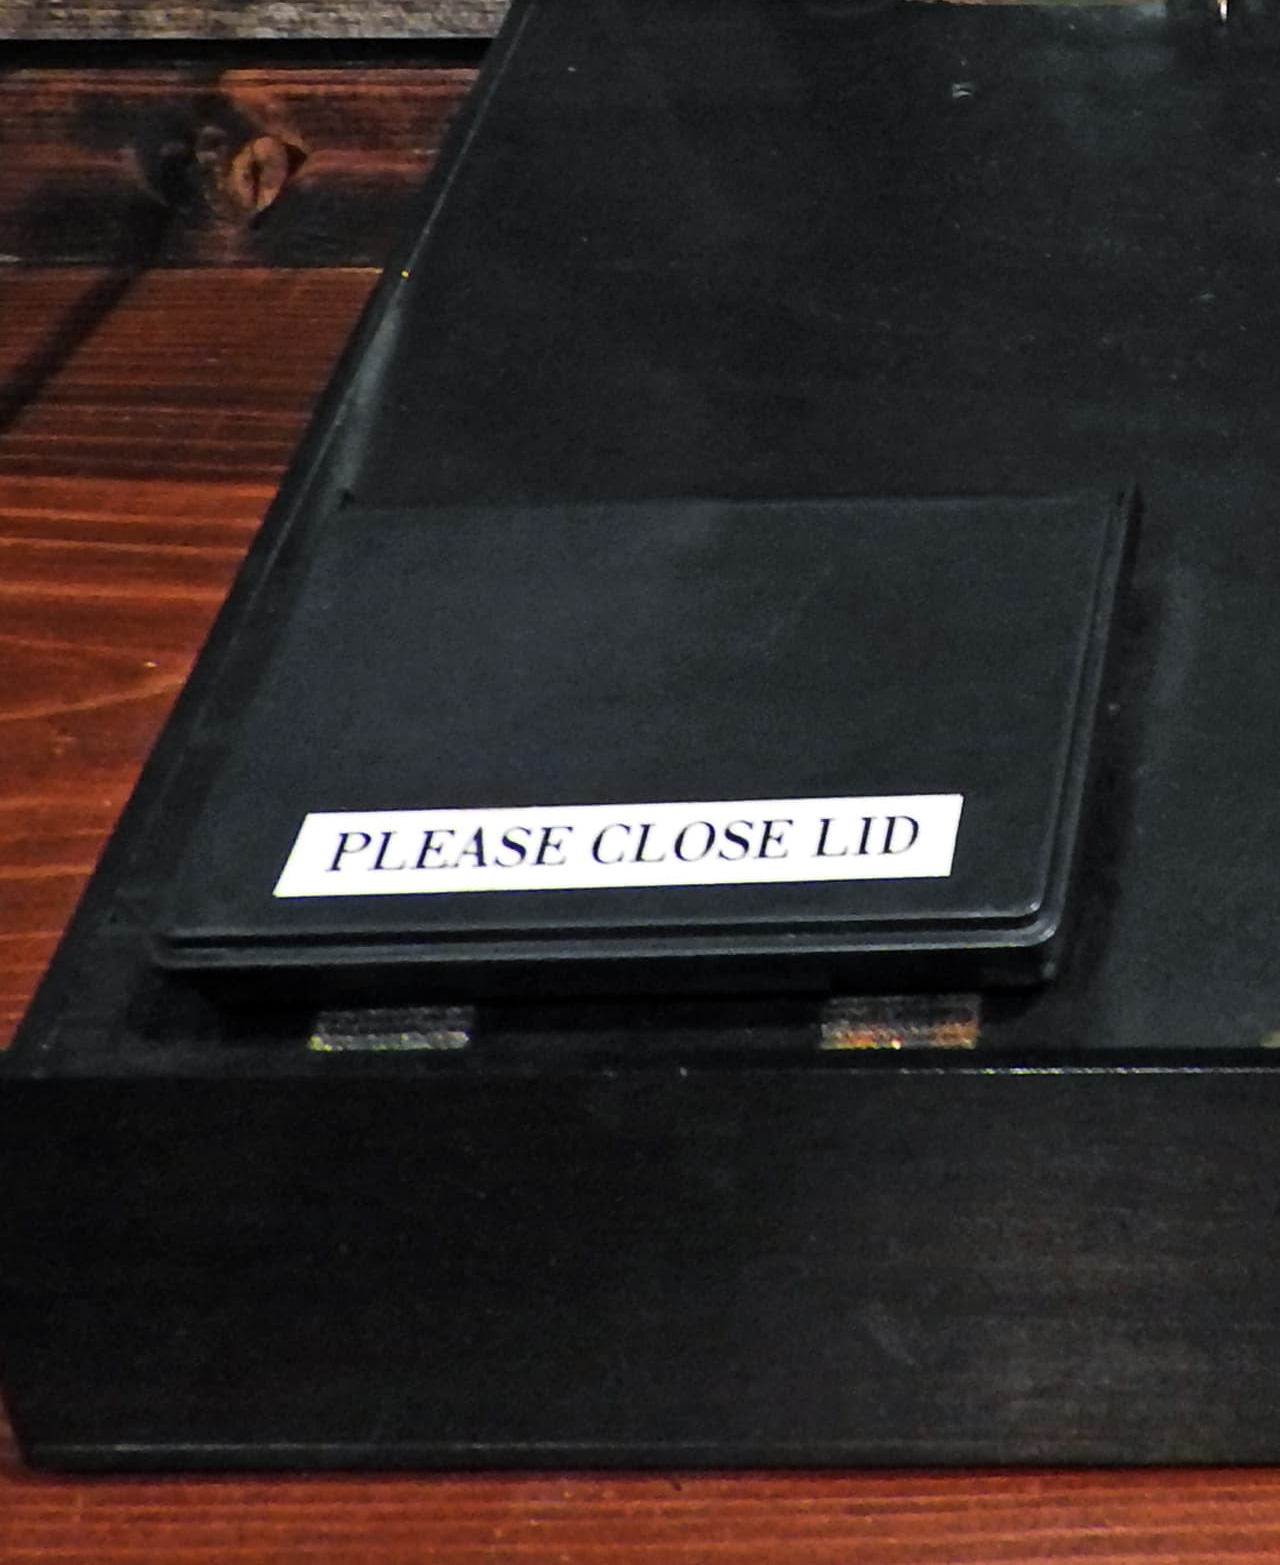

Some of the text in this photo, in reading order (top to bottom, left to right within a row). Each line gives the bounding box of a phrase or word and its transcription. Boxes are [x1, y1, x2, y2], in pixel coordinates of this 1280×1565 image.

[326, 814, 921, 872] PLEASE CLOSE LID
